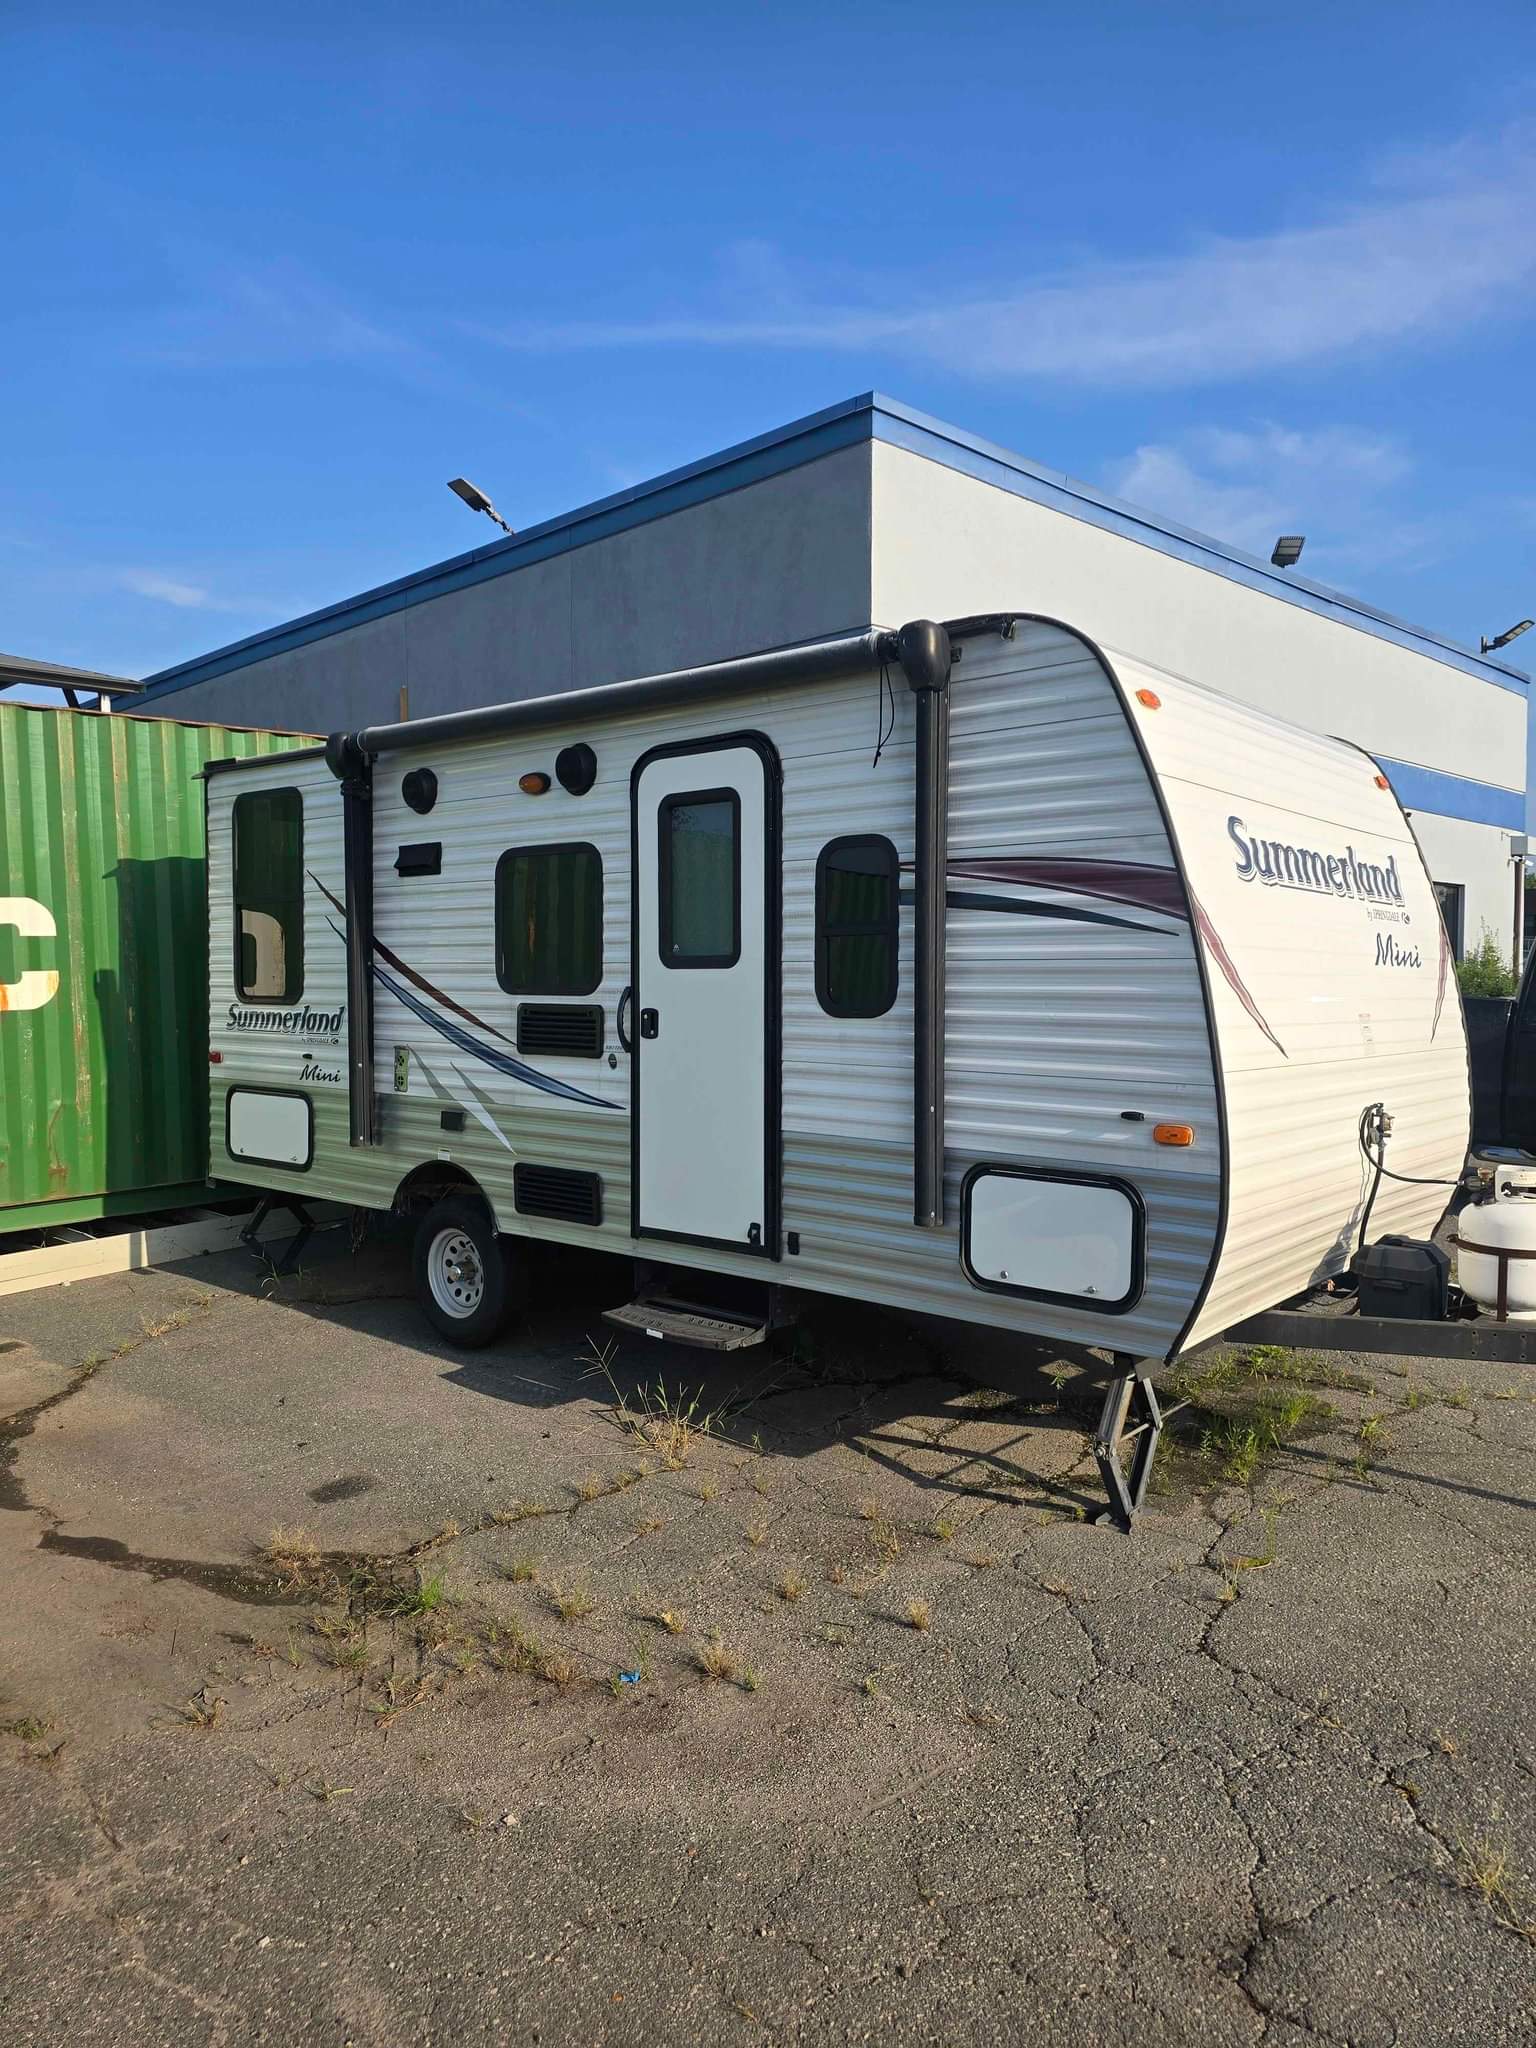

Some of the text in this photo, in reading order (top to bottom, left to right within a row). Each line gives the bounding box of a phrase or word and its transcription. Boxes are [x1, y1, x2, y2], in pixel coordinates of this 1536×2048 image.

[1227, 815, 1405, 906] Summerland
[1375, 932, 1422, 968] Mini
[226, 1003, 345, 1036] Summerland
[299, 1063, 341, 1083] Mini
